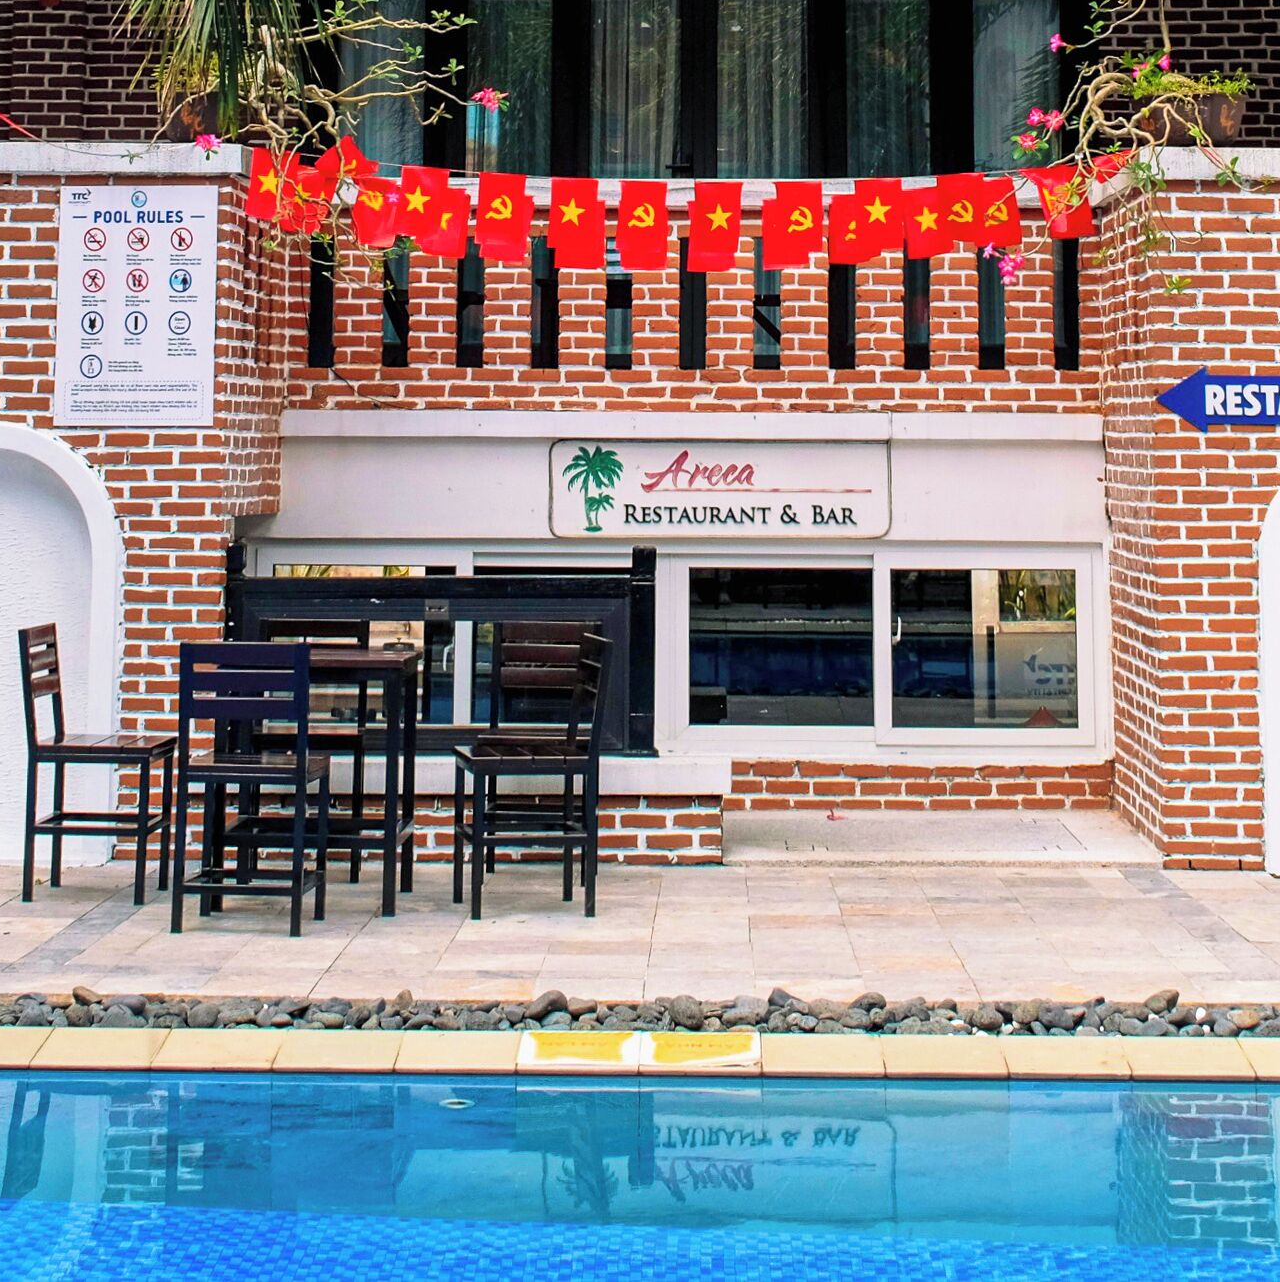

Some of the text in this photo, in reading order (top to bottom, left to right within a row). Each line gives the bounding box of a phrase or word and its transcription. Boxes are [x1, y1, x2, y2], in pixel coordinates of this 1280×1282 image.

[94, 211, 184, 223] POOL RULES
[641, 450, 755, 492] Areca
[624, 503, 857, 525] RESTAURANT & BAR
